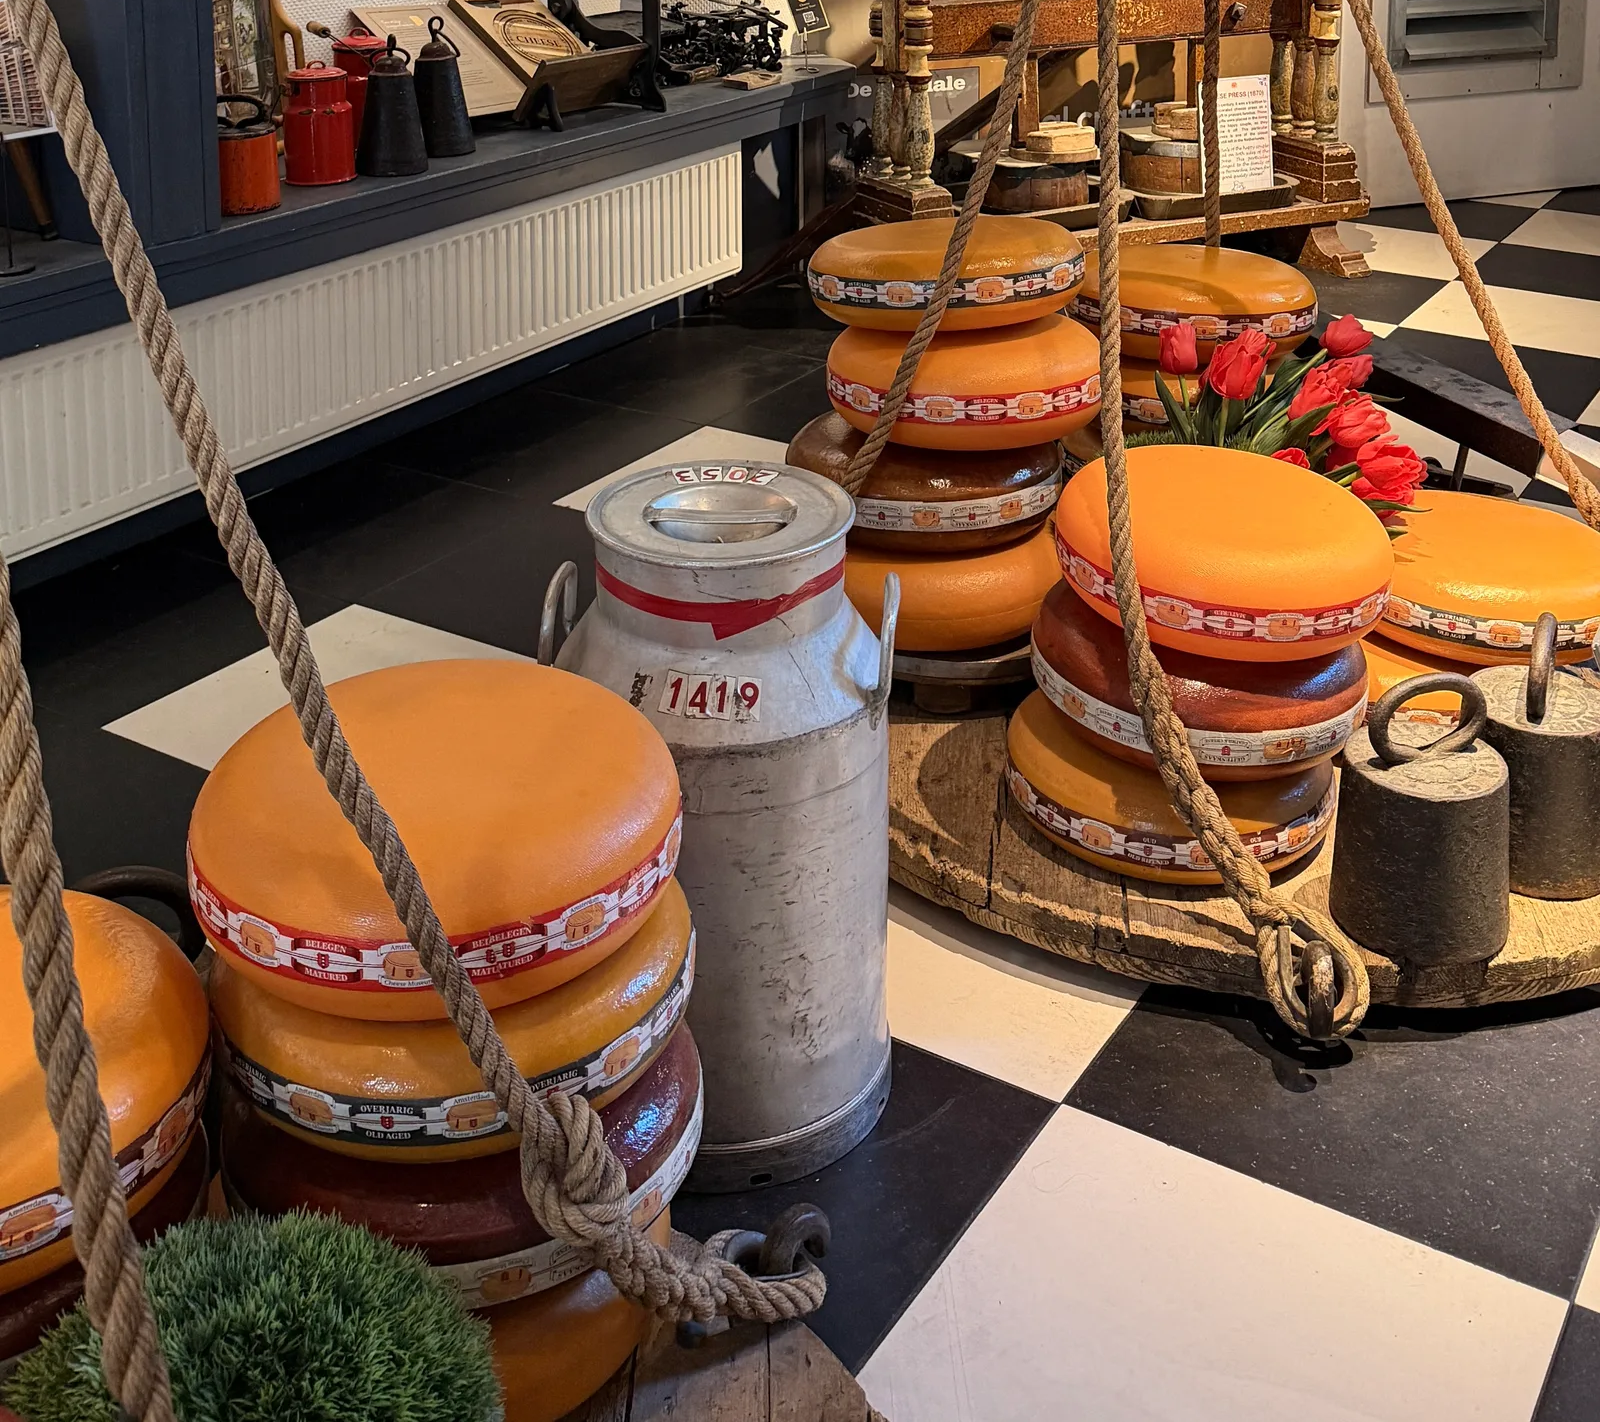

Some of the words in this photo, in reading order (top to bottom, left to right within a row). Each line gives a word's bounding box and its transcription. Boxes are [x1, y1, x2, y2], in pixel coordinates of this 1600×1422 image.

[516, 36, 561, 48] CHEESE
[1248, 90, 1264, 98] (1870)
[1212, 610, 1246, 618] MATURED
[1213, 628, 1244, 636] BELEGEN
[670, 677, 760, 714] 1419
[1142, 836, 1157, 844] OUD
[1127, 852, 1140, 861] OLD
[1141, 855, 1170, 866] RIPENED
[571, 895, 600, 914] Amsterdam
[305, 939, 347, 954] BELEGEN
[498, 954, 533, 970] ATURED
[304, 967, 348, 982] MATURED
[384, 979, 407, 987] Cheese
[530, 1069, 578, 1092] OVERJARIG
[294, 1085, 325, 1100] Amsterdam
[360, 1104, 414, 1115] OVERJARIG
[365, 1130, 383, 1139] OLD
[385, 1131, 411, 1140] AGED
[8, 1197, 49, 1217] Amsterdam
